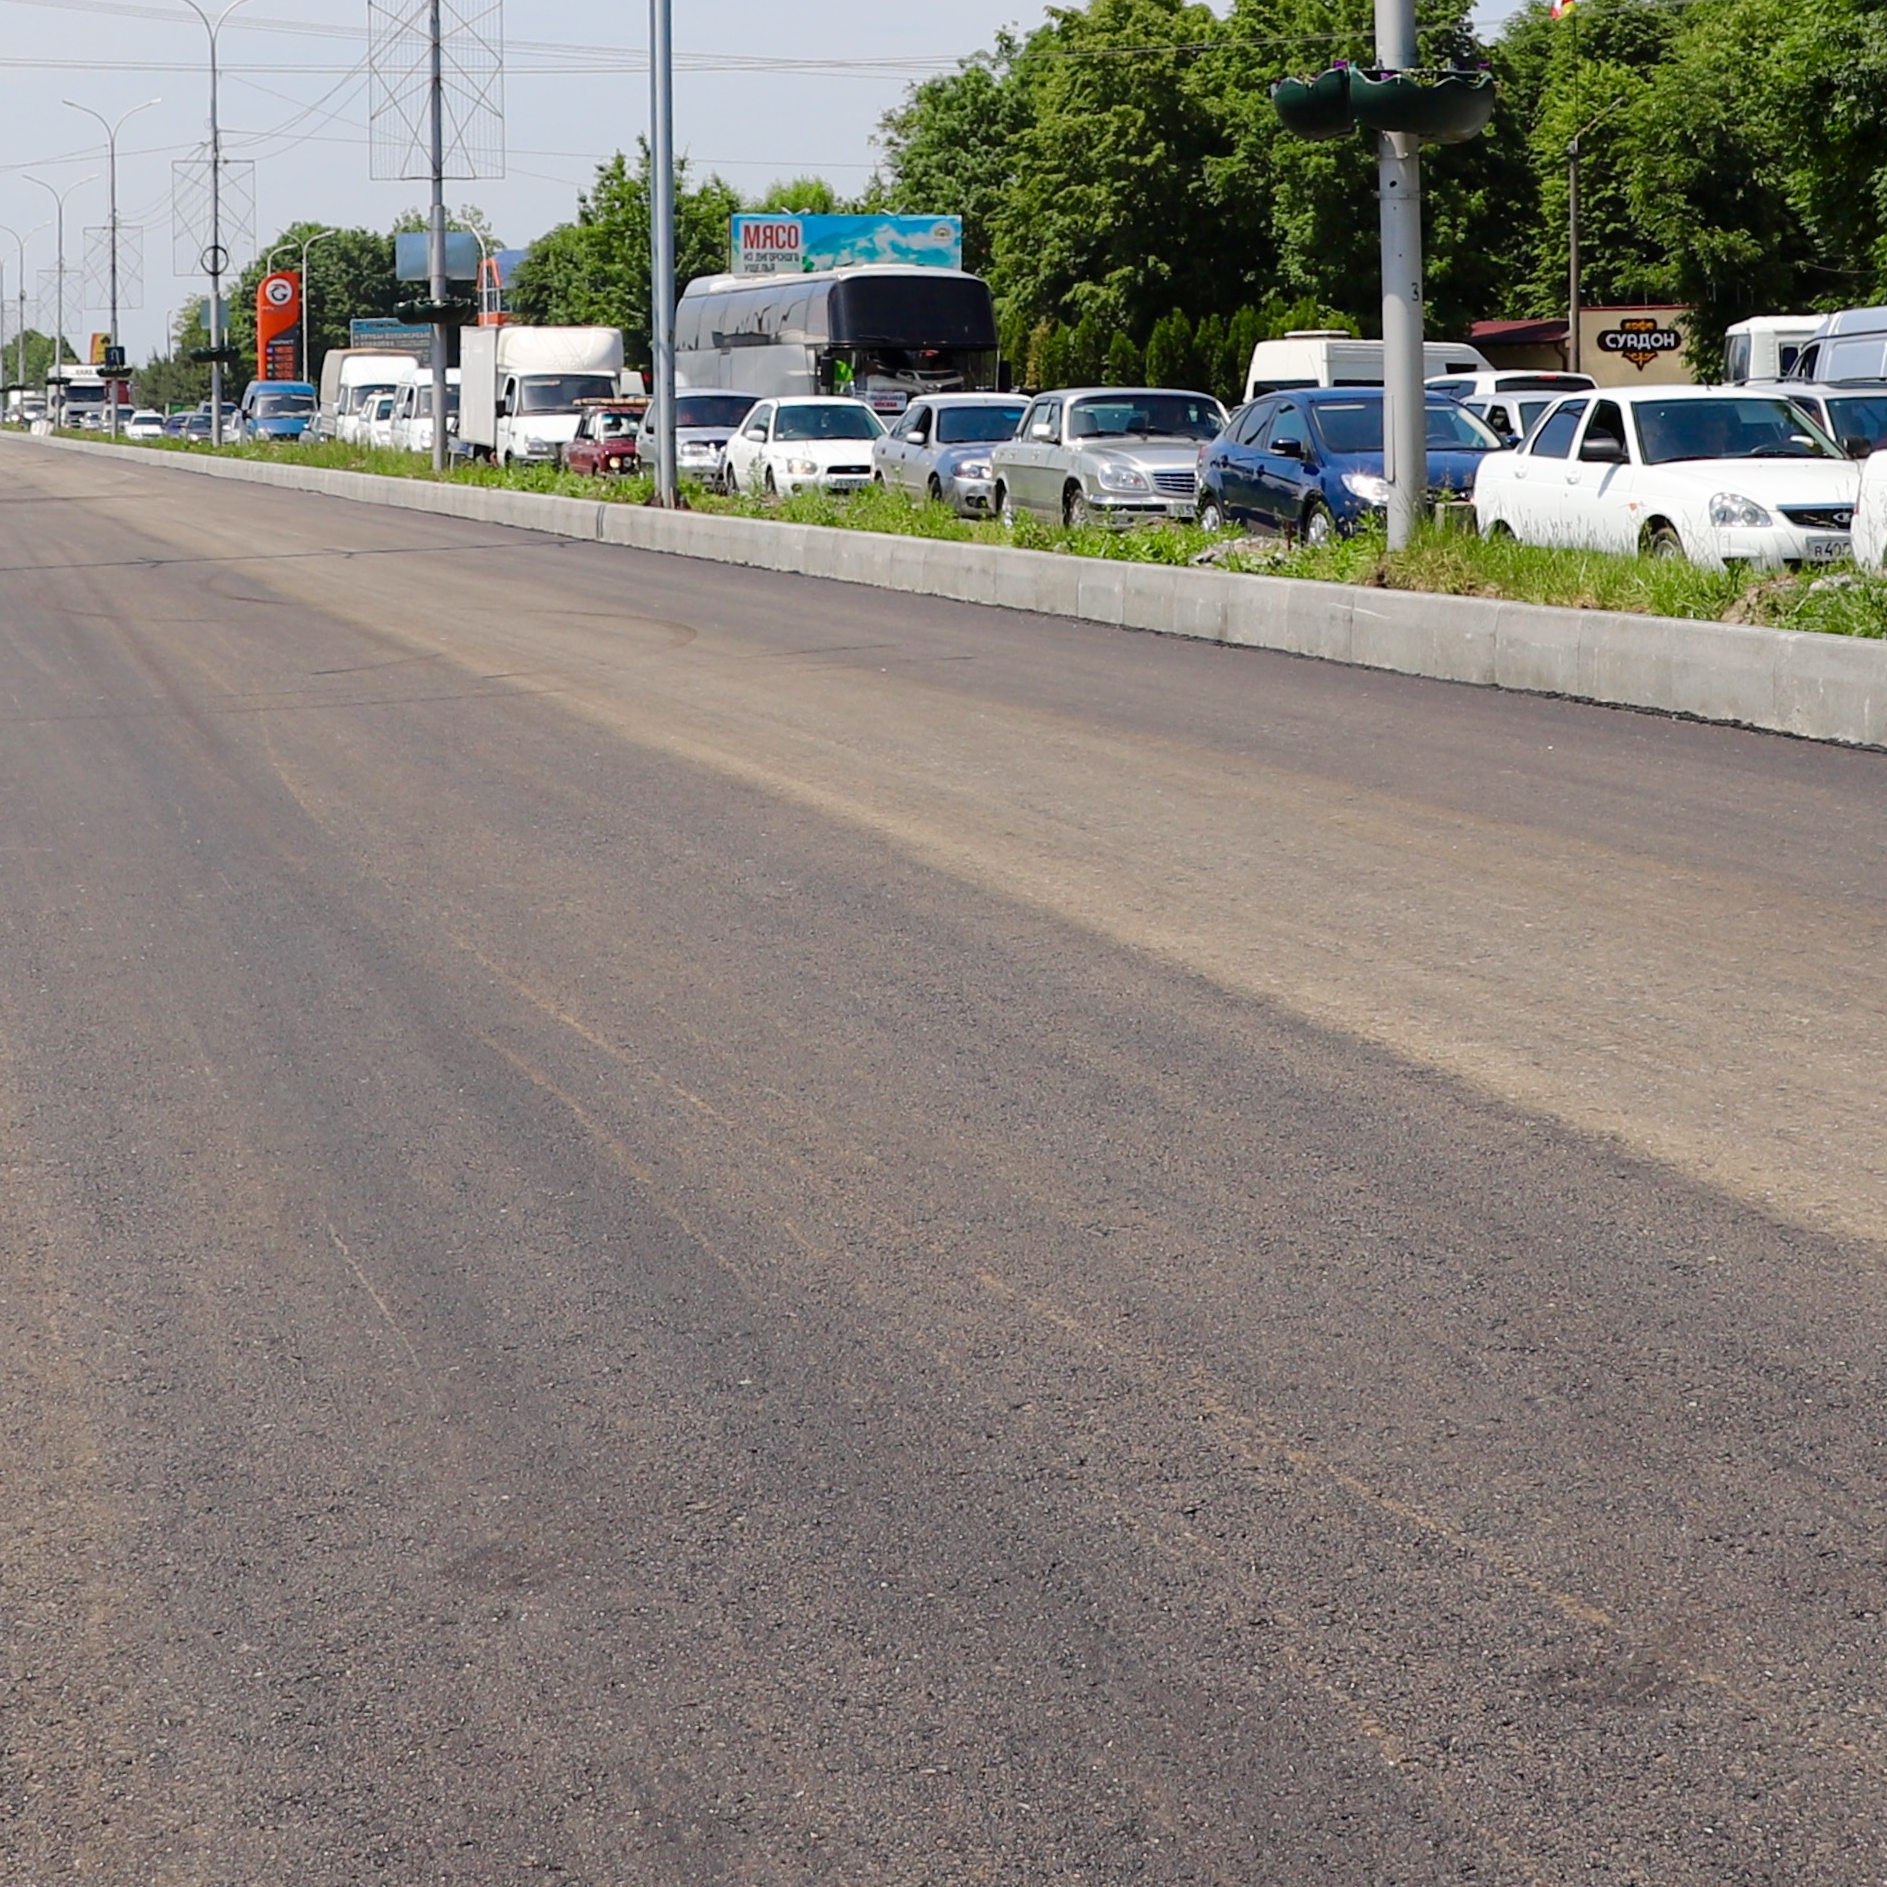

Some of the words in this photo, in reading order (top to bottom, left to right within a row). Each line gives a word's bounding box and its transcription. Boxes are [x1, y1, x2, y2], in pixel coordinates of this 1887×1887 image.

[743, 224, 799, 250] МЯСО
[1411, 281, 1420, 302] 3
[1604, 332, 1675, 351] СУАДОН
